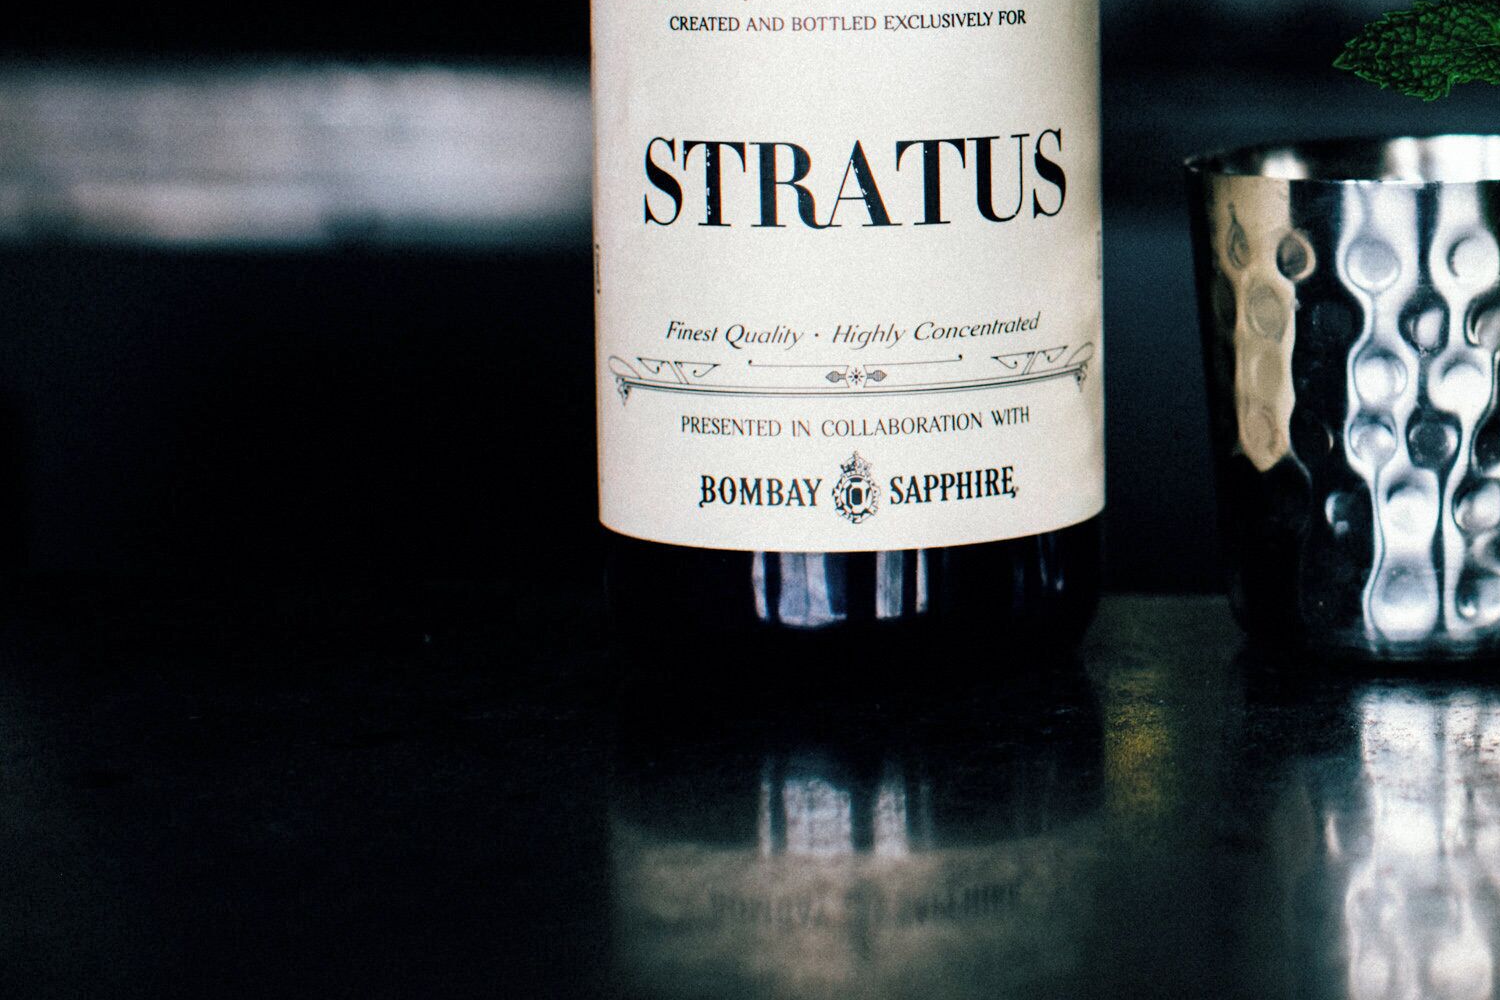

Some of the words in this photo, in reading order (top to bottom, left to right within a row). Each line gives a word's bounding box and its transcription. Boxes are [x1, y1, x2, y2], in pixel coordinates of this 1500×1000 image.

[669, 15, 740, 32] CREATED
[746, 16, 785, 32] AND
[791, 15, 877, 32] BOTTLED
[883, 11, 994, 32] EXCLUSIVELY
[998, 9, 1027, 26] FOR
[644, 127, 1067, 230] STRATUS
[665, 319, 719, 342] Finest
[724, 323, 804, 351] Quality
[832, 323, 906, 351] Highly
[913, 310, 1042, 342] Concentrated
[680, 414, 782, 438] PRESENTED
[791, 419, 811, 438] IN
[820, 411, 983, 438] COLLABORATION
[990, 405, 1031, 425] WITH
[699, 474, 823, 508] BOMBAY
